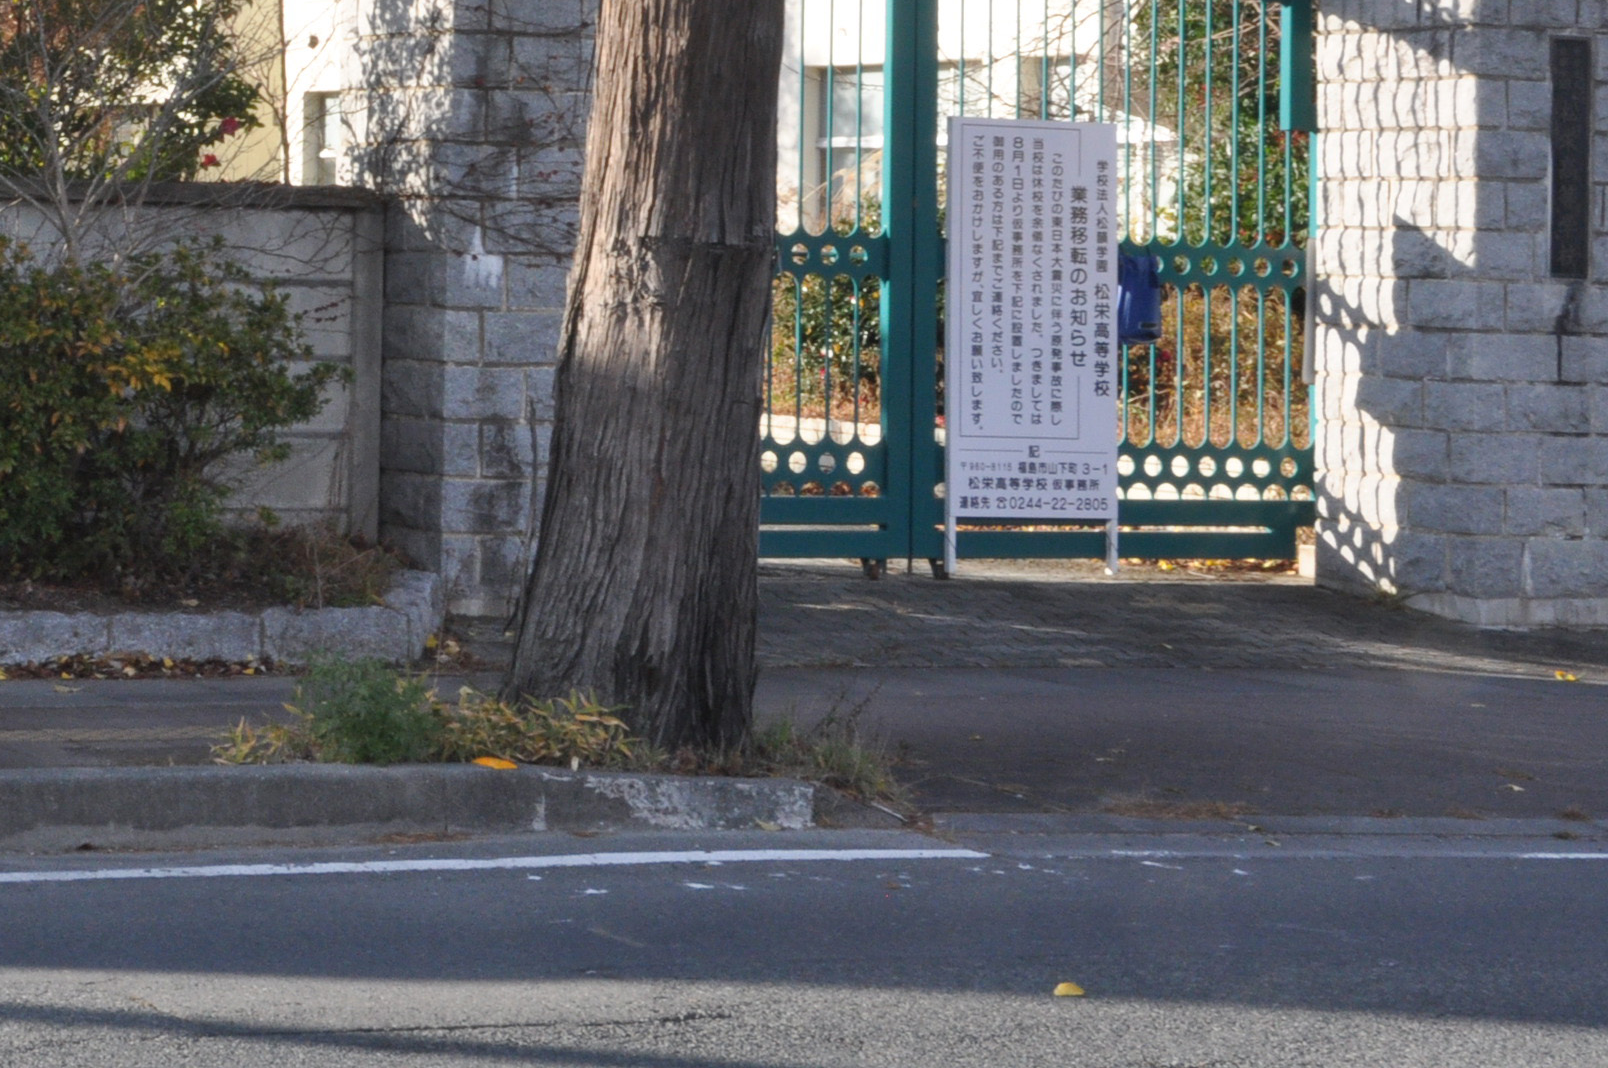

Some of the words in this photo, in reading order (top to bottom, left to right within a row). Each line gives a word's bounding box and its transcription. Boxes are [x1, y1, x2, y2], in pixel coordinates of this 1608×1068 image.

[1070, 186, 1088, 368] 業務移転のお知らせ
[1094, 283, 1110, 397] 松栄高等学校
[1028, 445, 1040, 458] 記
[968, 476, 1048, 491] 松栄高等学校
[959, 496, 990, 509] 連絡先
